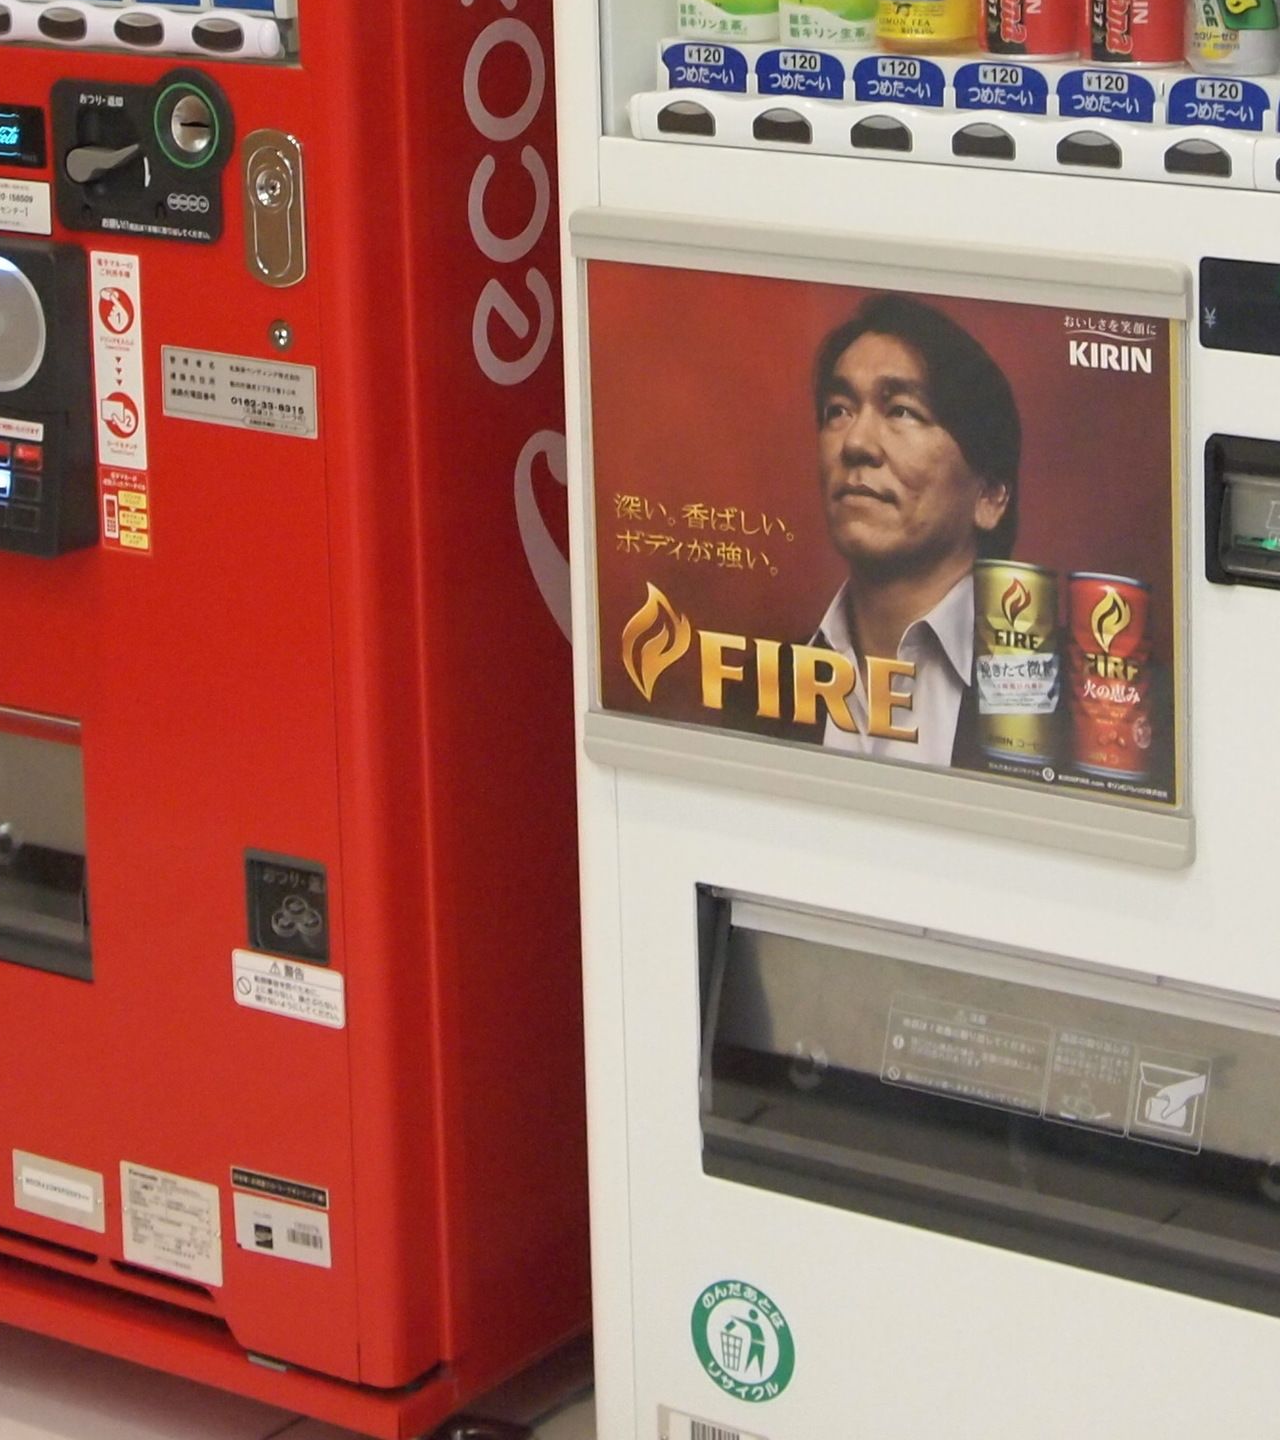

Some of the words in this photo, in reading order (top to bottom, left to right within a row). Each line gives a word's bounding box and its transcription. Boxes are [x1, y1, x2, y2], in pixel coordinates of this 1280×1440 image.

[783, 53, 818, 69] ¥120
[881, 60, 917, 77] ¥120
[1087, 74, 1125, 91] ¥120
[1199, 82, 1239, 99] ¥120
[1064, 315, 1157, 336] おいしさを笑顔に
[1069, 340, 1152, 374] KIRIN
[614, 492, 795, 542] 深い。香ばしい。
[615, 531, 780, 576] ボディが強い。
[995, 630, 1041, 649] FIRE
[698, 628, 919, 743] FIRE
[702, 1283, 785, 1329] のんだあとは
[708, 1361, 779, 1400] リサイクル
